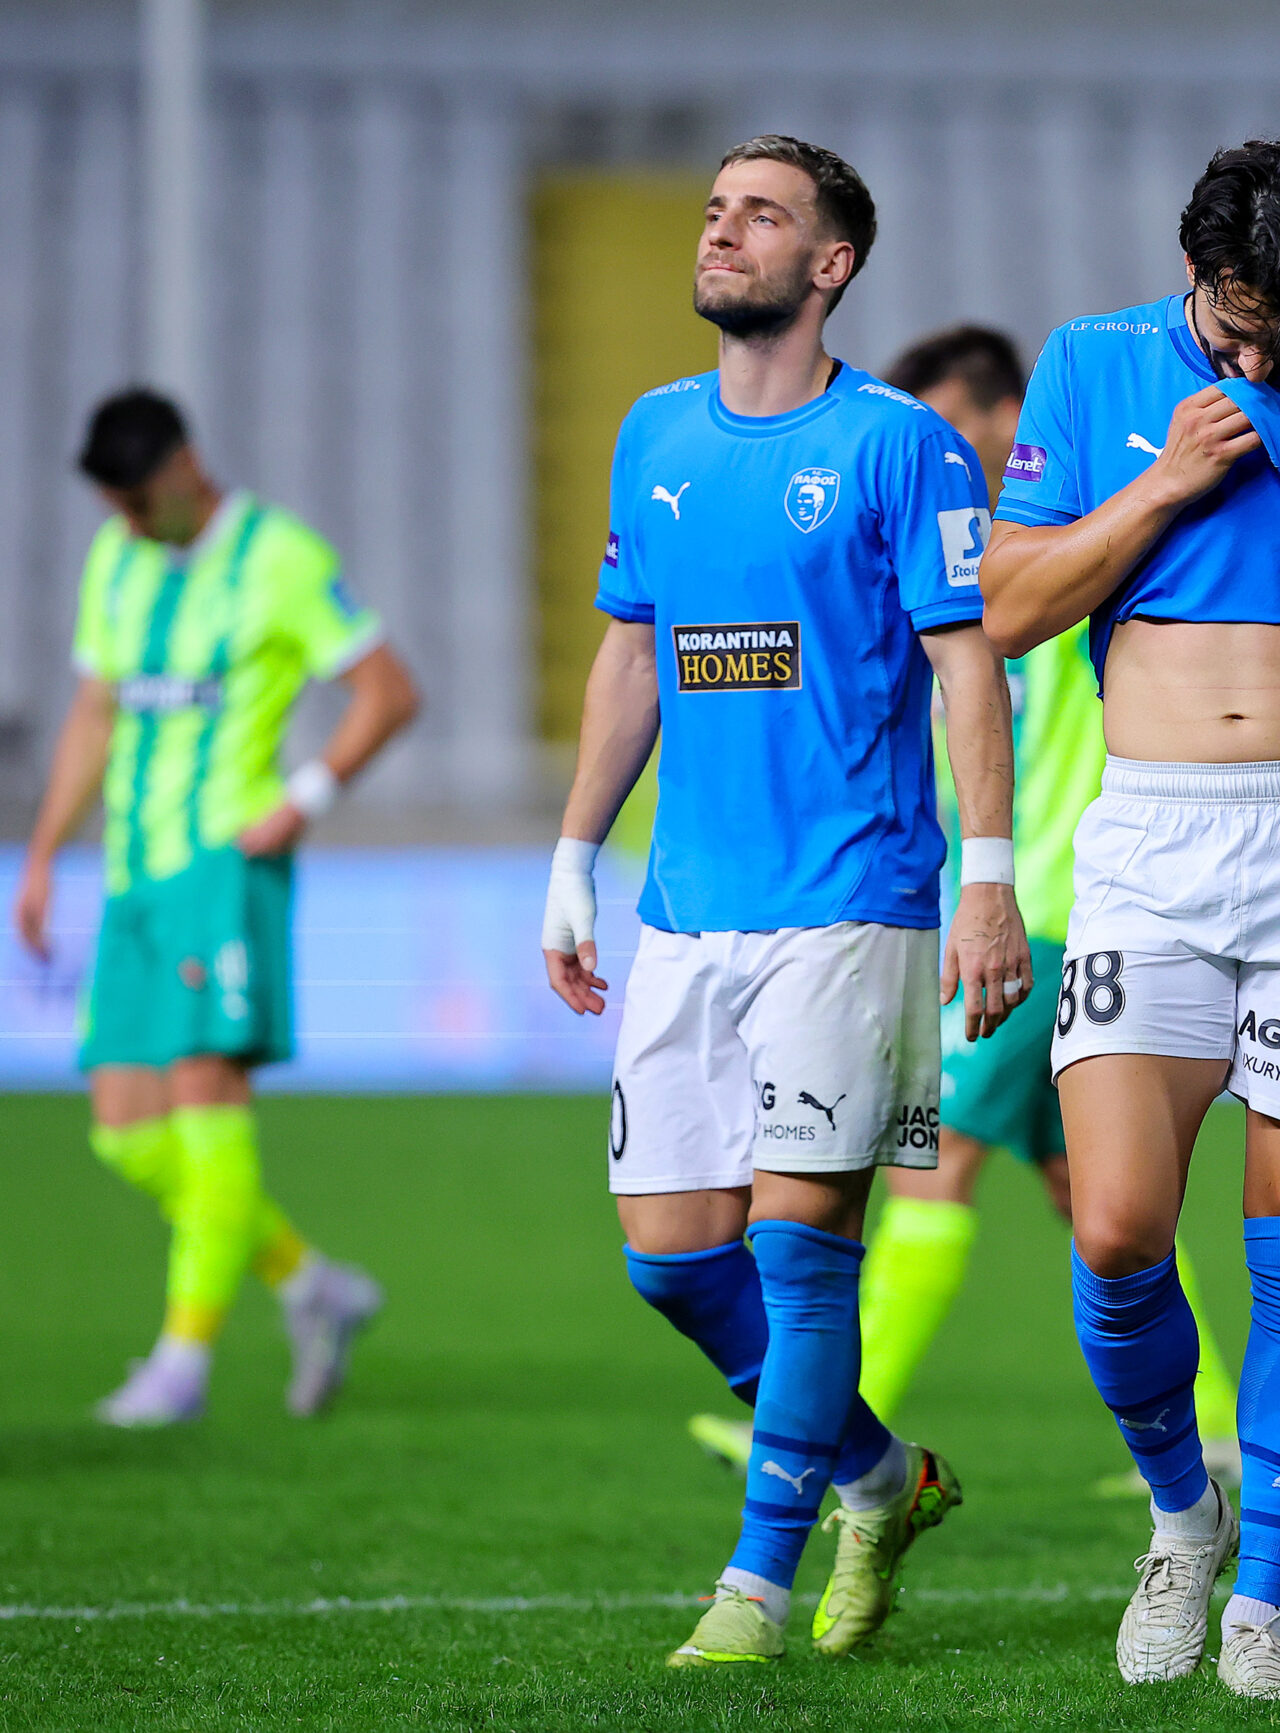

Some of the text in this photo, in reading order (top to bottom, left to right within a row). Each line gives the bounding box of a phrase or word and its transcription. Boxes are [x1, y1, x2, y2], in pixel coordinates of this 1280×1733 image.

[1070, 322, 1091, 331] LF
[857, 383, 928, 412] FONBET
[678, 630, 794, 651] KORANTINA
[681, 652, 792, 684] HOMES
[897, 1104, 940, 1128] JAC
[763, 1124, 816, 1141] HOMES
